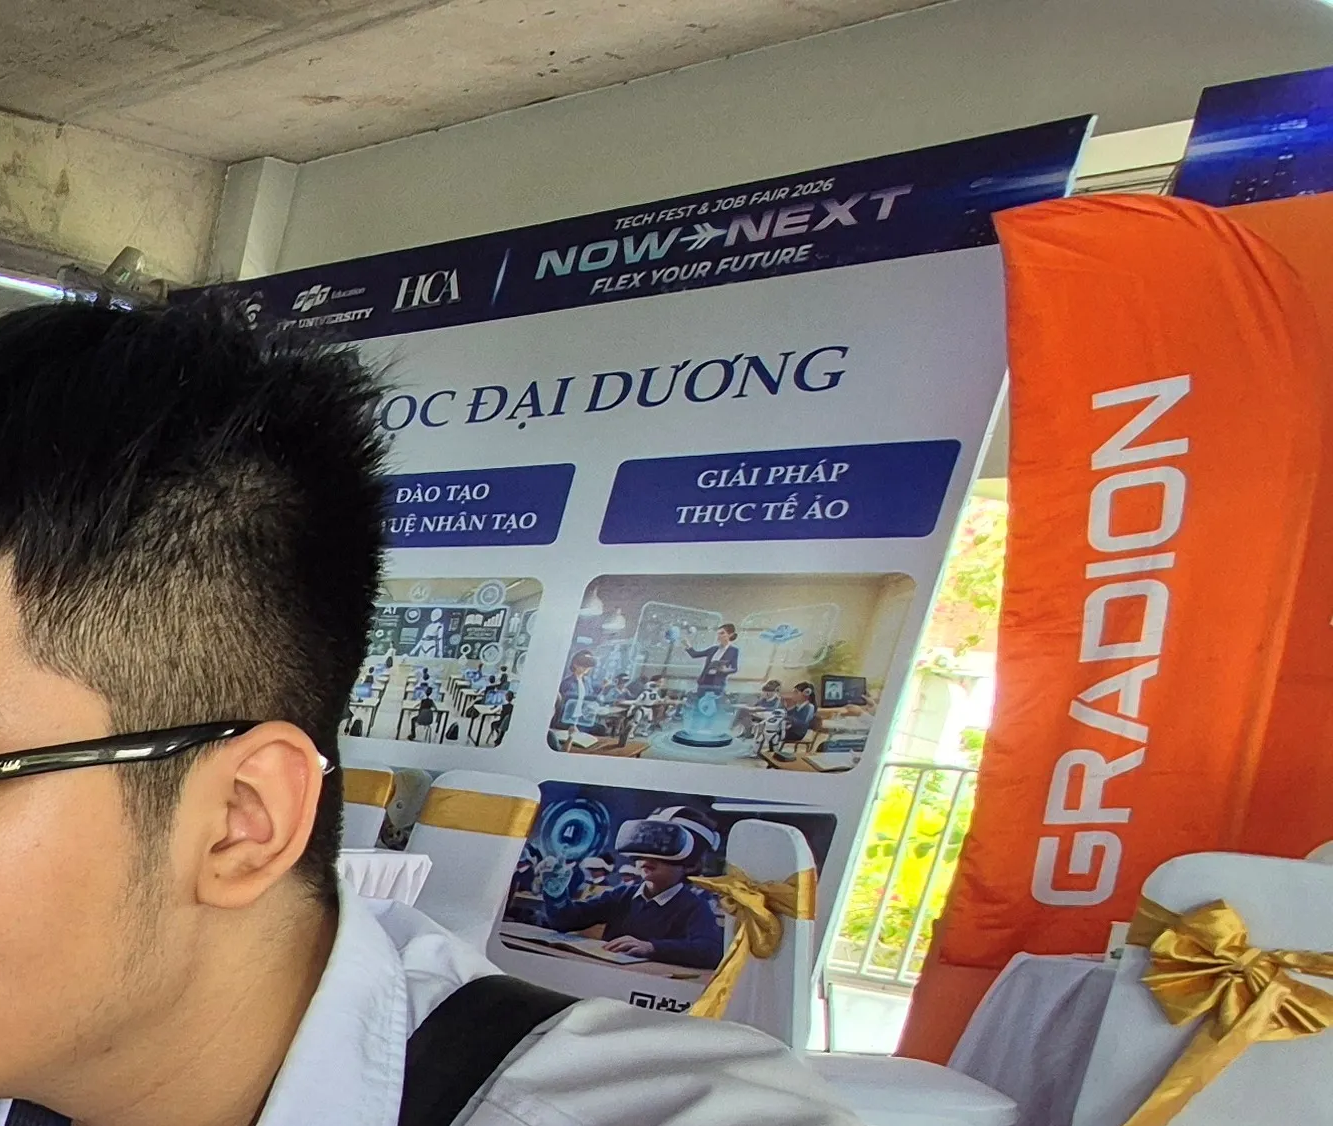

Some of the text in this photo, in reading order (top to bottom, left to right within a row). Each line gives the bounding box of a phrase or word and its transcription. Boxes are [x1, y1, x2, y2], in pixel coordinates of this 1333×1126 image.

[614, 177, 835, 232] TECH FEST & JOB FAIR 2026
[534, 183, 915, 280] NOW NEXT
[392, 268, 461, 313] HCA
[590, 243, 815, 296] FLEX YOUR FUTURE
[298, 307, 374, 329] UNIVERSITY
[465, 376, 576, 430] ĐẠI
[585, 344, 849, 414] DƯƠNG
[396, 483, 489, 504] ĐÀO TẠO
[697, 458, 850, 489] GIẢI PHÁP
[419, 511, 487, 533] NHÂN
[492, 512, 537, 534] TẠO
[676, 492, 850, 527] THỰC TẾ ẢO
[1031, 374, 1192, 907] GRADION
